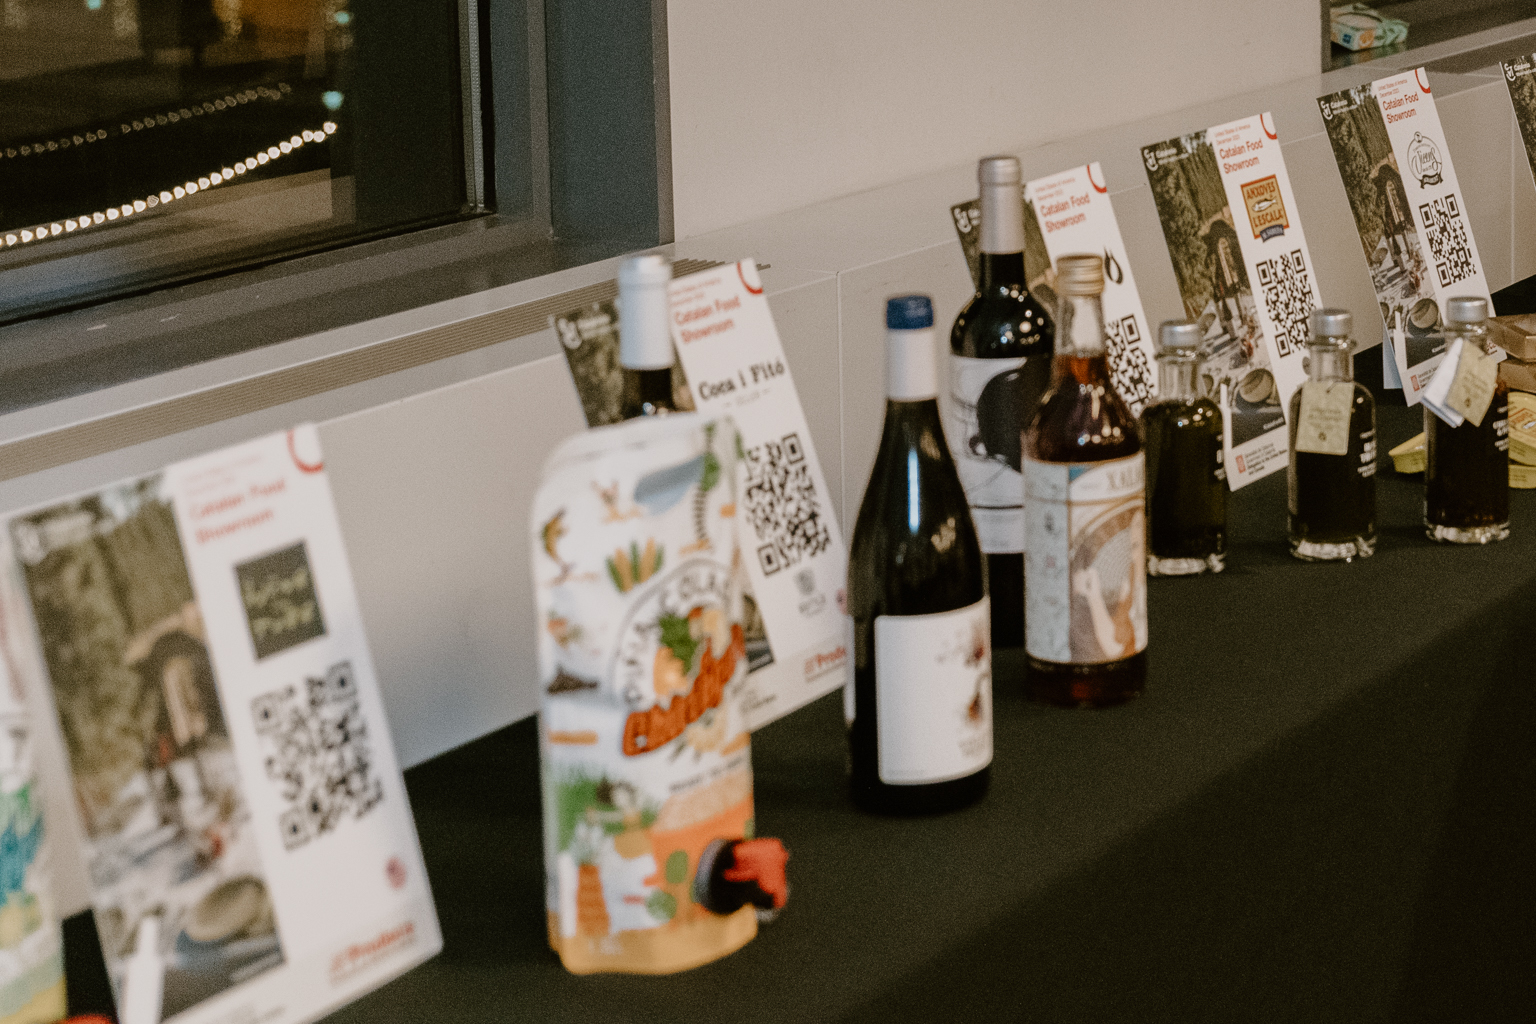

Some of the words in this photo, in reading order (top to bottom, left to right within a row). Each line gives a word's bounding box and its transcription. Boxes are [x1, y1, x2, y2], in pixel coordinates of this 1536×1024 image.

[1382, 97, 1404, 111] Catalan
[1404, 91, 1419, 105] Food
[1386, 108, 1417, 124] Showroom
[1219, 144, 1245, 160] Catalan
[1245, 138, 1263, 153] Food
[1223, 156, 1260, 174] Showroom
[1246, 181, 1276, 200] ANXOVES
[1040, 200, 1070, 218] Catalan
[1070, 192, 1090, 207] Food
[1045, 212, 1087, 233] Showroom
[674, 305, 713, 326] Catalan
[715, 295, 742, 312] Food
[680, 318, 735, 344] Showroom
[698, 379, 736, 401] Coca
